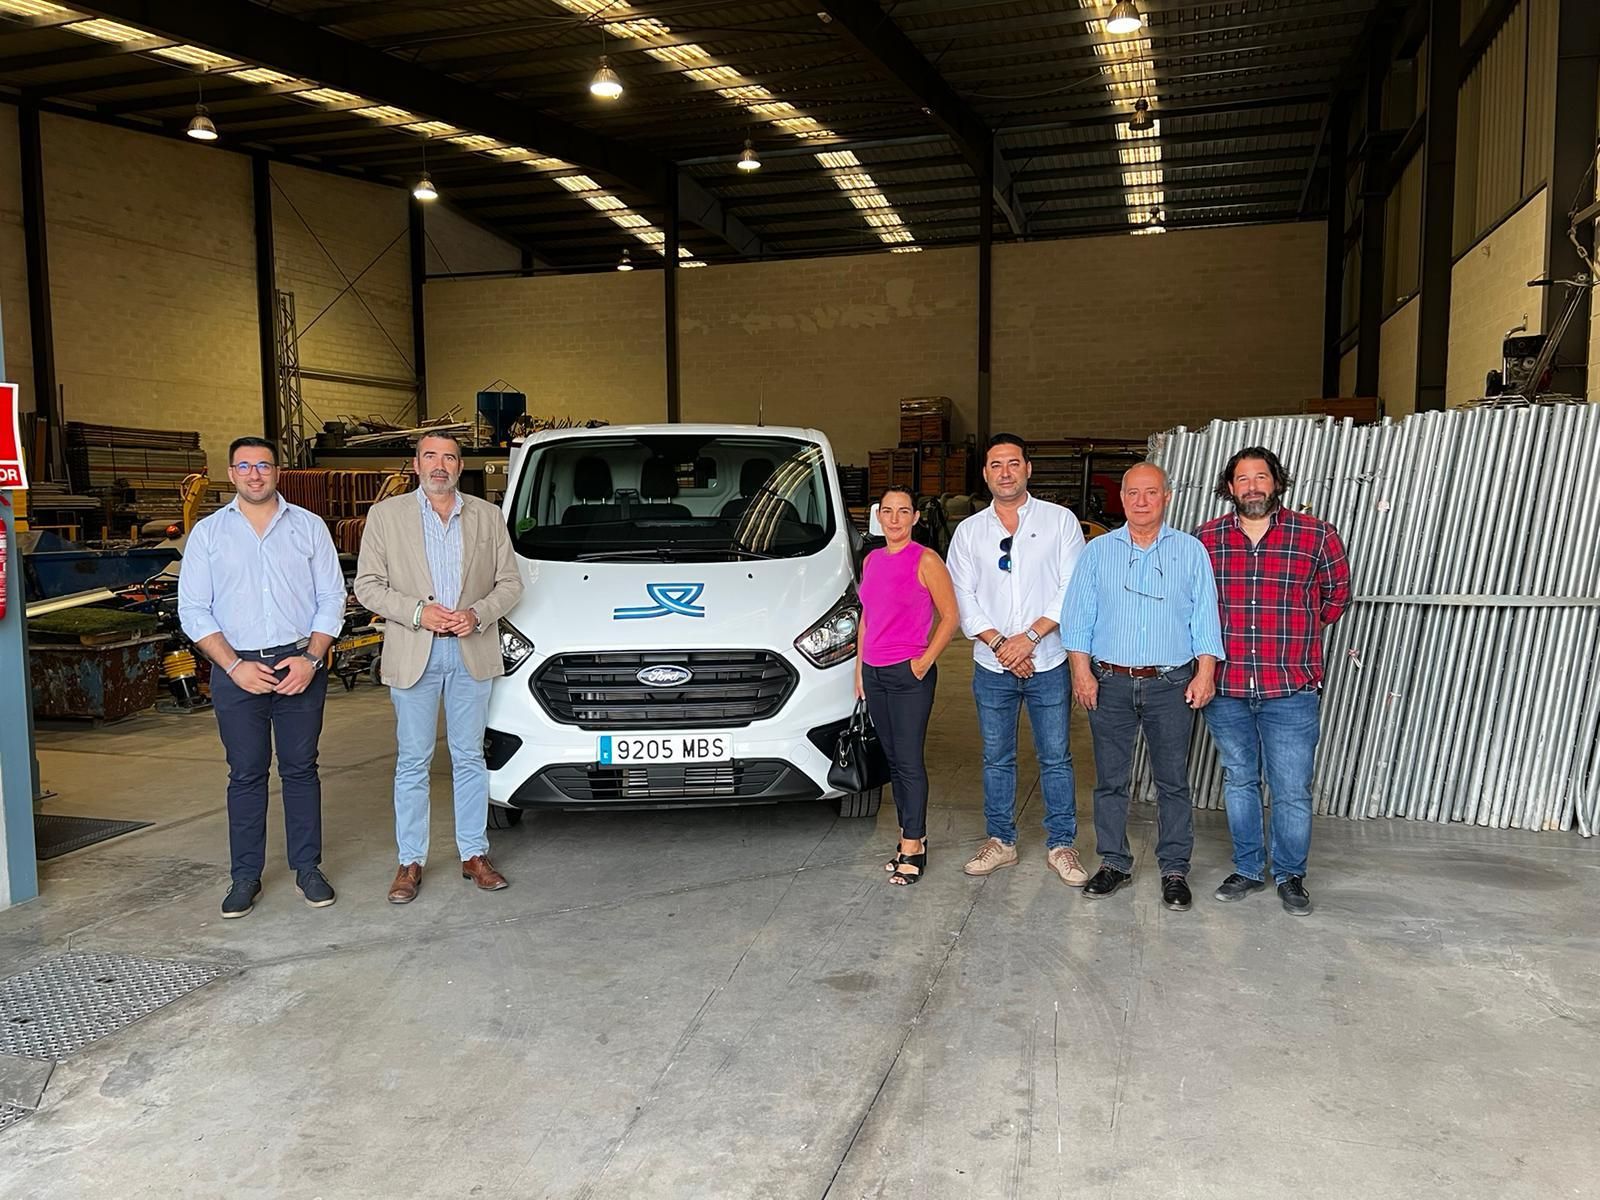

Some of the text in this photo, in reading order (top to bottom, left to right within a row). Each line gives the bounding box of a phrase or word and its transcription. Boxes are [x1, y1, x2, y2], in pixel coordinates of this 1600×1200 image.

[648, 668, 679, 681] Ford
[617, 738, 724, 759] 9205 MBS
